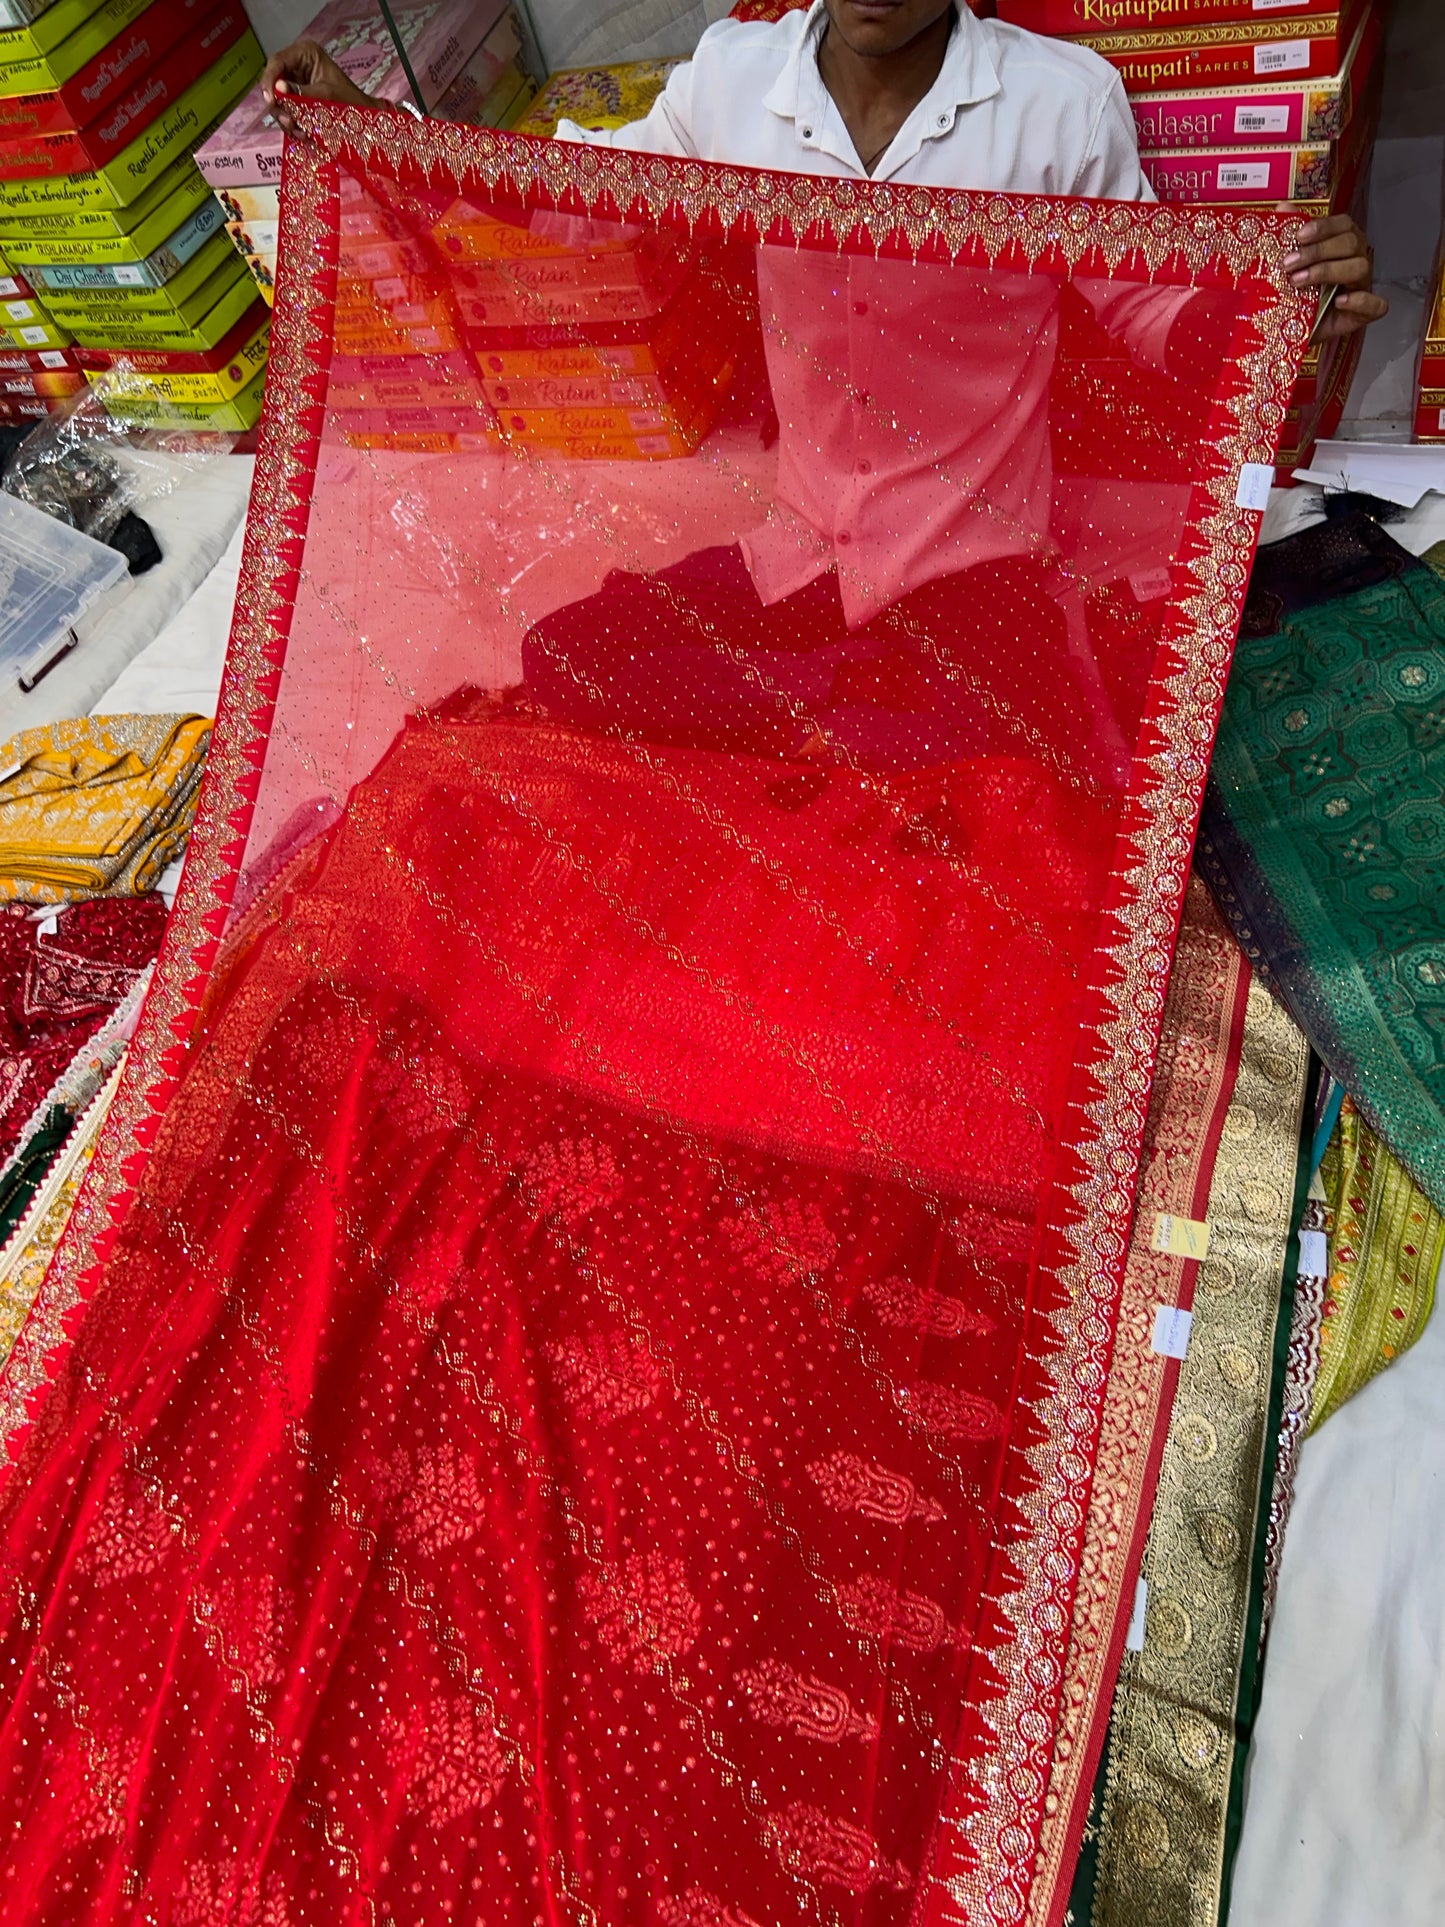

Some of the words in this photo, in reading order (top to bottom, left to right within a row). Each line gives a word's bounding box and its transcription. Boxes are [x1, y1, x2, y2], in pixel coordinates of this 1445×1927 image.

[1118, 56, 1191, 85] atupati
[1196, 60, 1249, 73] SAREES
[154, 107, 199, 150] Embroidery
[1137, 135, 1209, 147] AREES
[1151, 163, 1212, 190] lasar
[31, 182, 85, 207] Embroidery
[509, 263, 574, 289] Ratan
[531, 352, 594, 376] Ratan
[537, 380, 599, 406] Ratan
[556, 409, 616, 434] Ratan
